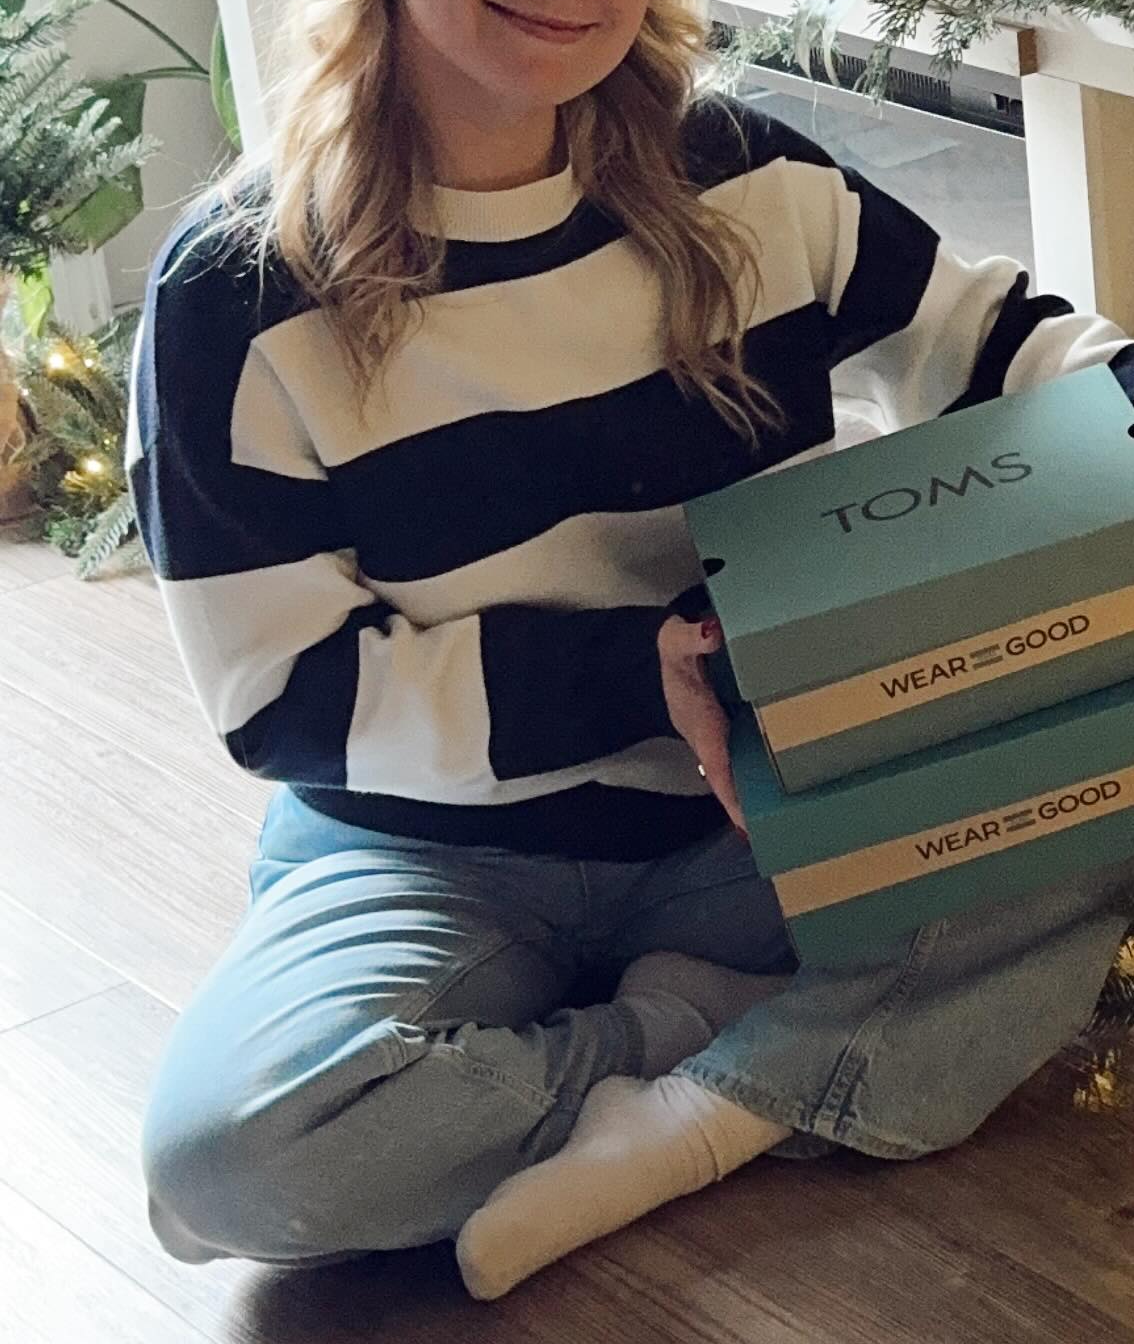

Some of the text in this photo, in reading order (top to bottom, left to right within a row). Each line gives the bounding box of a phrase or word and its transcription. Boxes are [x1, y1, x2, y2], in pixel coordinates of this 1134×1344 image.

[821, 452, 1032, 533] TOMS
[880, 656, 968, 698] WEAR
[1005, 615, 1090, 656] GOOD
[915, 821, 1000, 860] WEAR
[1038, 780, 1121, 820] GOOD
